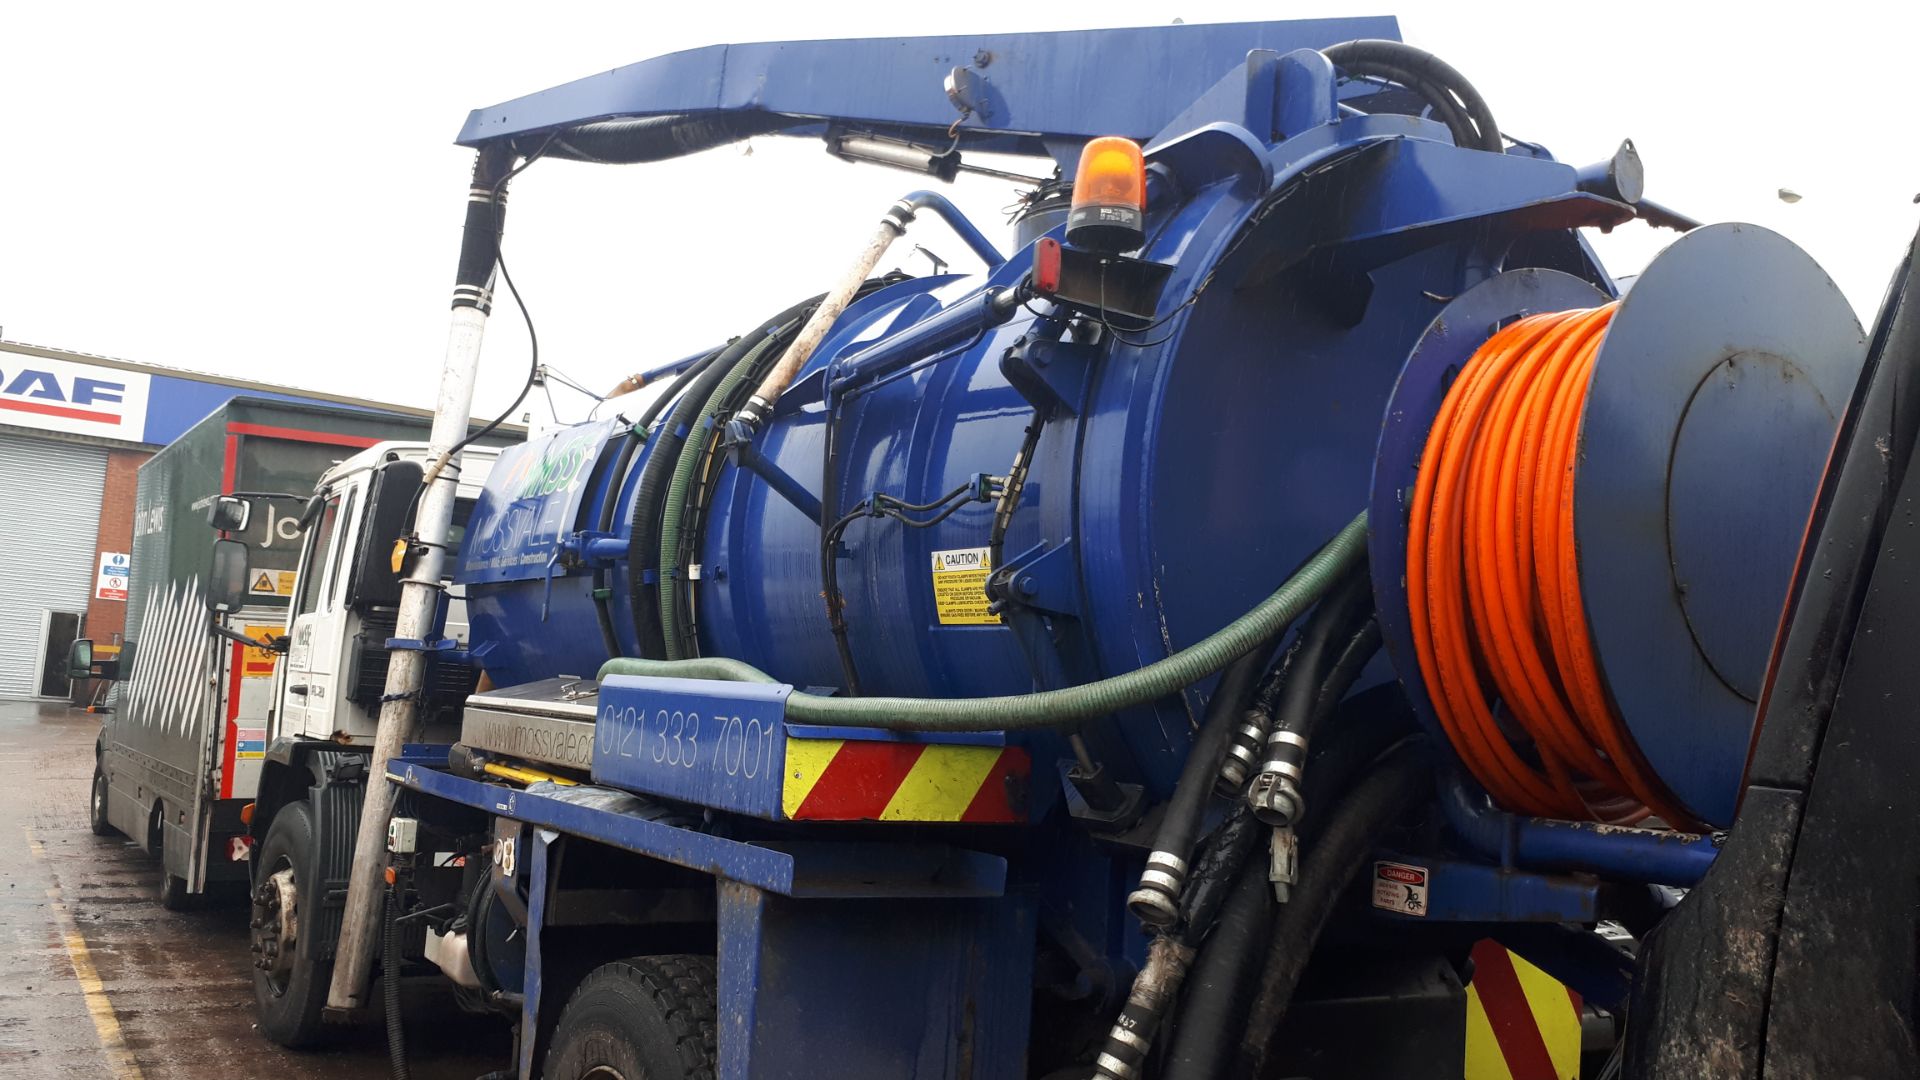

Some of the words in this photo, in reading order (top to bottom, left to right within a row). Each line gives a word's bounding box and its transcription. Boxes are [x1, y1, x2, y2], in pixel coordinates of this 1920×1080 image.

[0, 369, 125, 405] AF
[945, 552, 979, 565] CAUTION
[601, 704, 645, 759] 0121
[652, 709, 699, 768] 333
[713, 716, 775, 780] 7001
[1387, 869, 1415, 881] DANGER
